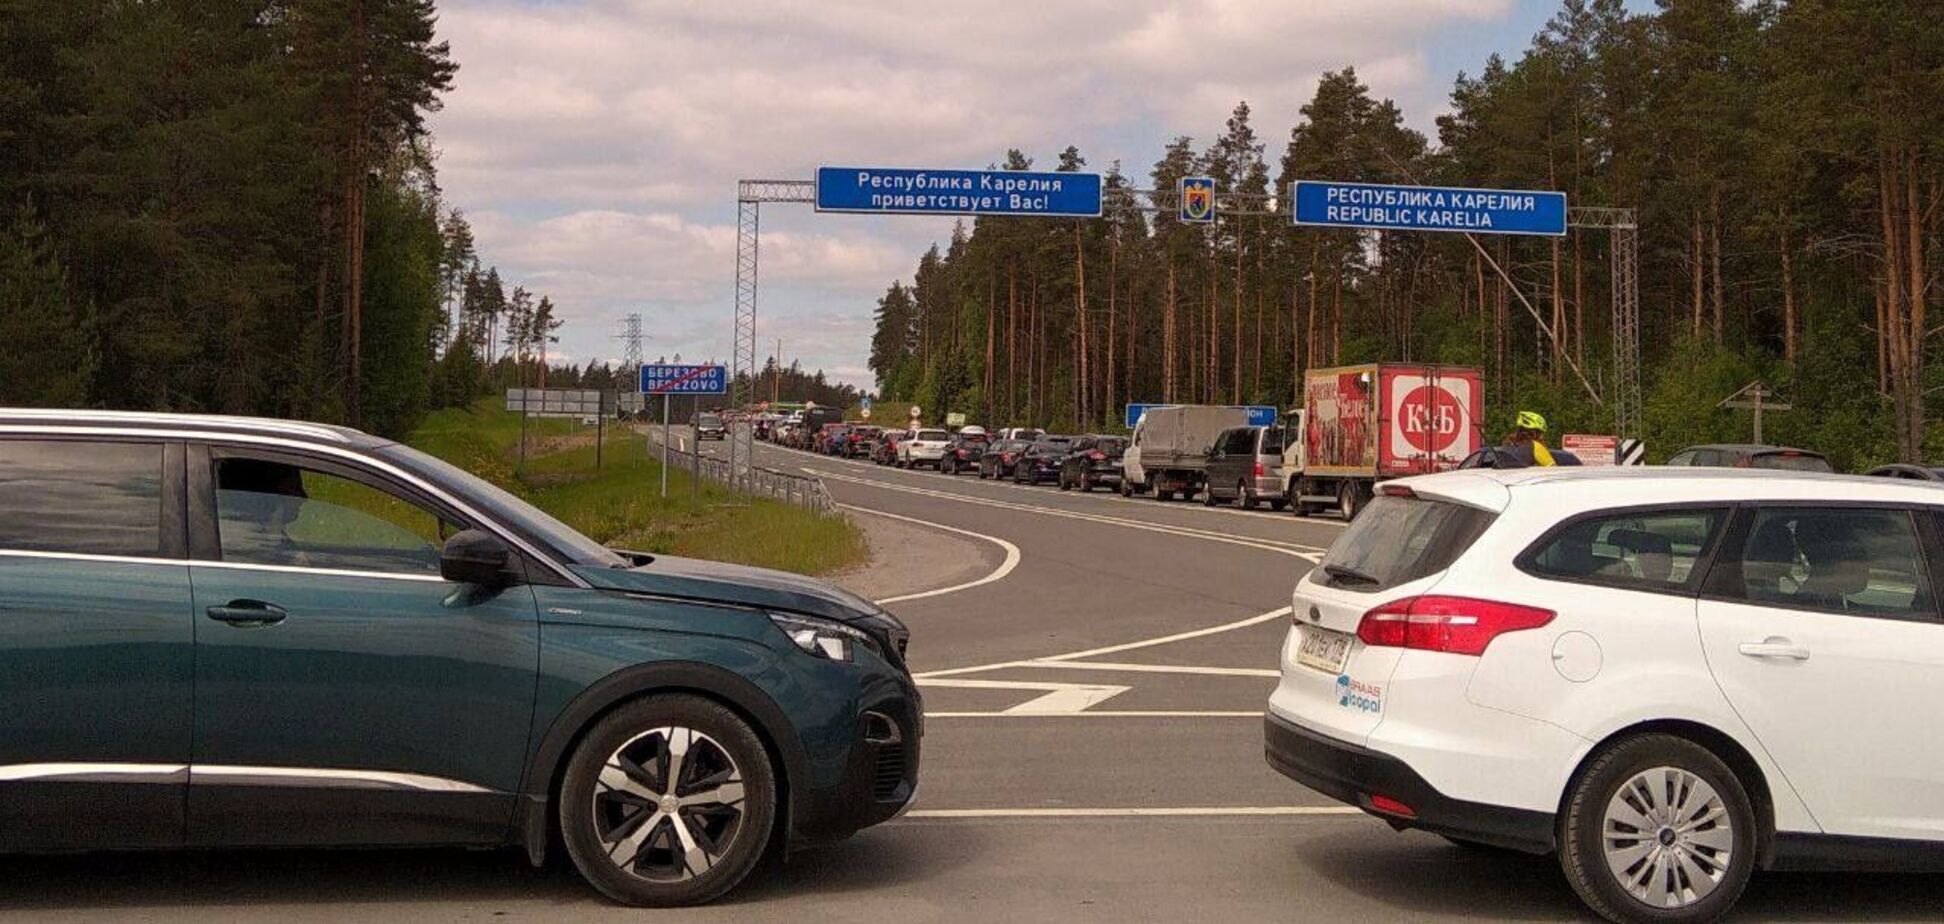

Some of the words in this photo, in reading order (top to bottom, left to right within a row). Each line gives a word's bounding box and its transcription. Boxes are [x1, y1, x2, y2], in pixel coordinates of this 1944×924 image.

[858, 172, 972, 192] Республика
[980, 175, 1062, 193] Карелия
[872, 193, 1001, 210] приветствует
[1009, 194, 1049, 210] Вас!
[1327, 187, 1446, 208] РЕСПУБЛИКА
[1451, 193, 1535, 212] КАРЕЛИЯ
[1327, 205, 1411, 224] REPUBLIC
[1417, 209, 1492, 228] KARELIA
